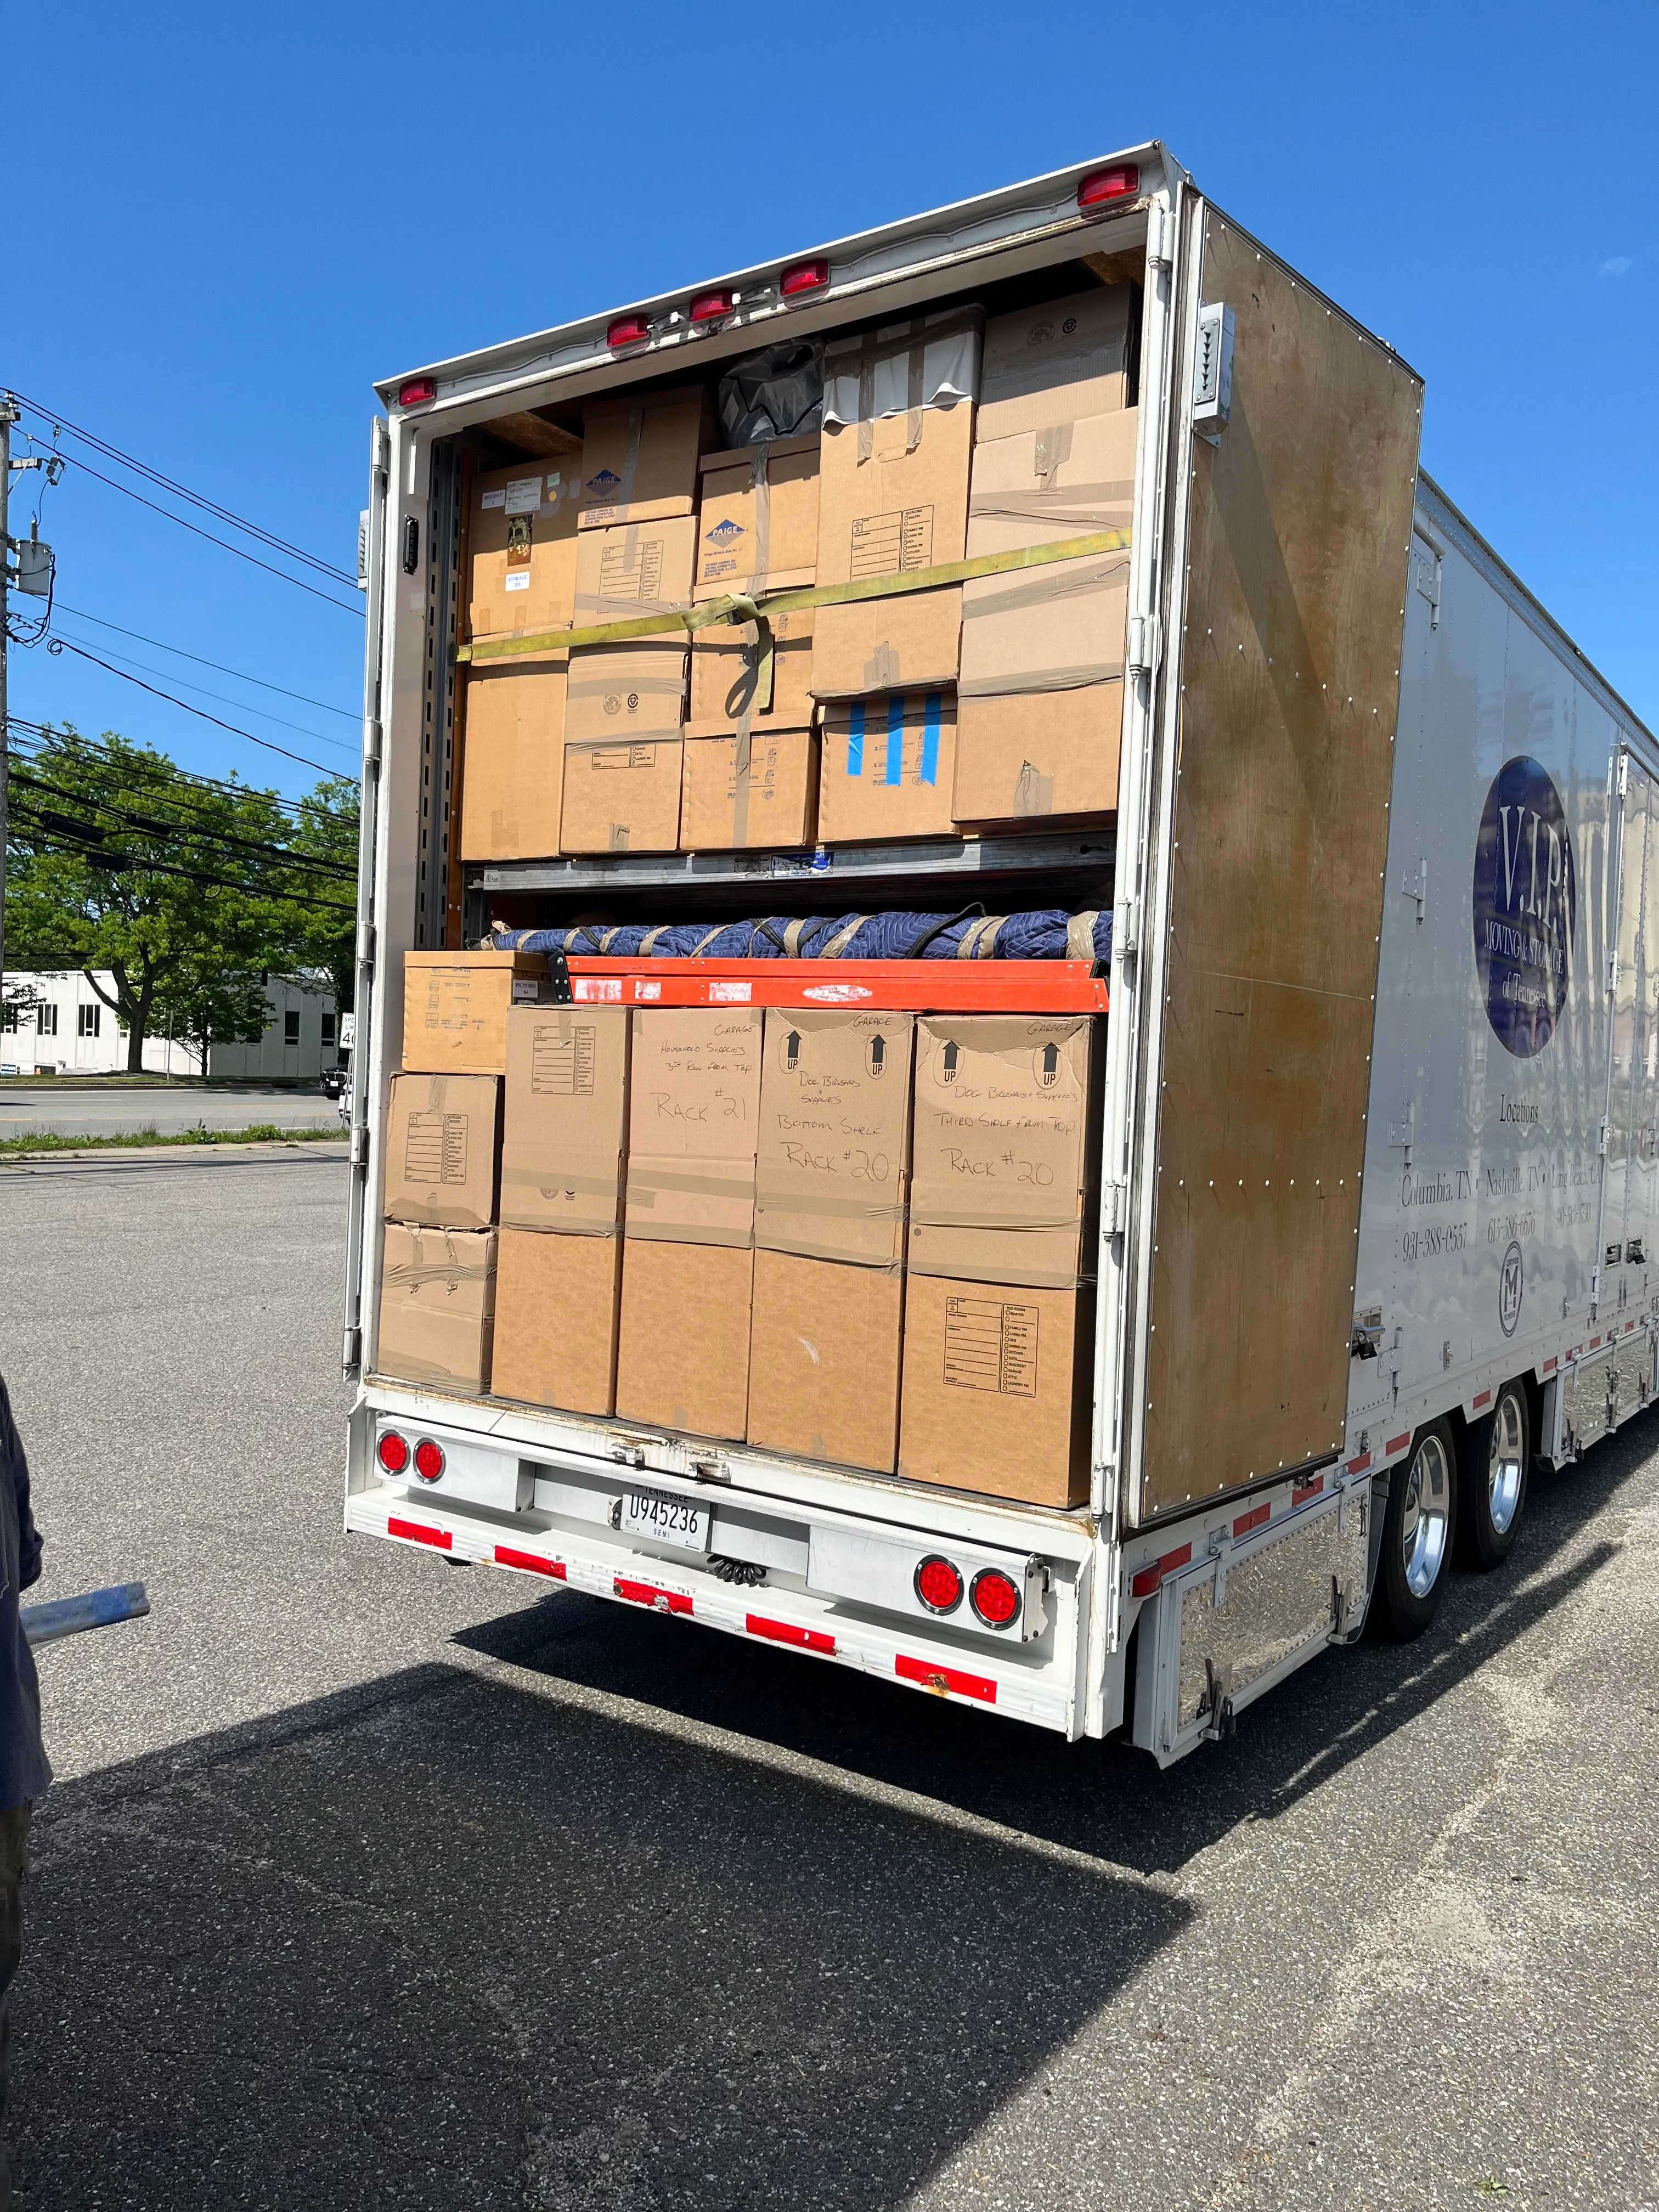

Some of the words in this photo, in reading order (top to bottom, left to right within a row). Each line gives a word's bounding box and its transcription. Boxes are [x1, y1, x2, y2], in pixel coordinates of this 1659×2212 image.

[593, 476, 616, 486] PAIGE
[713, 526, 738, 537] PAIGE
[1484, 919, 1521, 958] MOVING
[1522, 935, 1528, 961] &
[1529, 937, 1564, 974] STORAGE
[1502, 971, 1511, 998] of
[1513, 973, 1546, 1008] Tennessee
[714, 1024, 756, 1036] GARAGE
[853, 1015, 894, 1027] GARAGE
[1027, 1022, 1071, 1035] GARAGE
[788, 1059, 798, 1070] UP
[873, 1064, 883, 1075] UP
[944, 1070, 956, 1082] UP
[1044, 1074, 1056, 1085] UP
[651, 1092, 708, 1122] RACK
[1499, 1094, 1538, 1124] Locations
[780, 1142, 838, 1172] RACK
[940, 1148, 996, 1177] RACK
[1402, 1172, 1453, 1207] Columbia,
[1455, 1170, 1474, 1200] TN
[1486, 1167, 1524, 1197] Nashville,
[1528, 1165, 1541, 1192] TN
[1551, 1164, 1567, 1195] Long
[630, 1494, 698, 1533] U945236
[653, 1528, 669, 1539] SEMI
